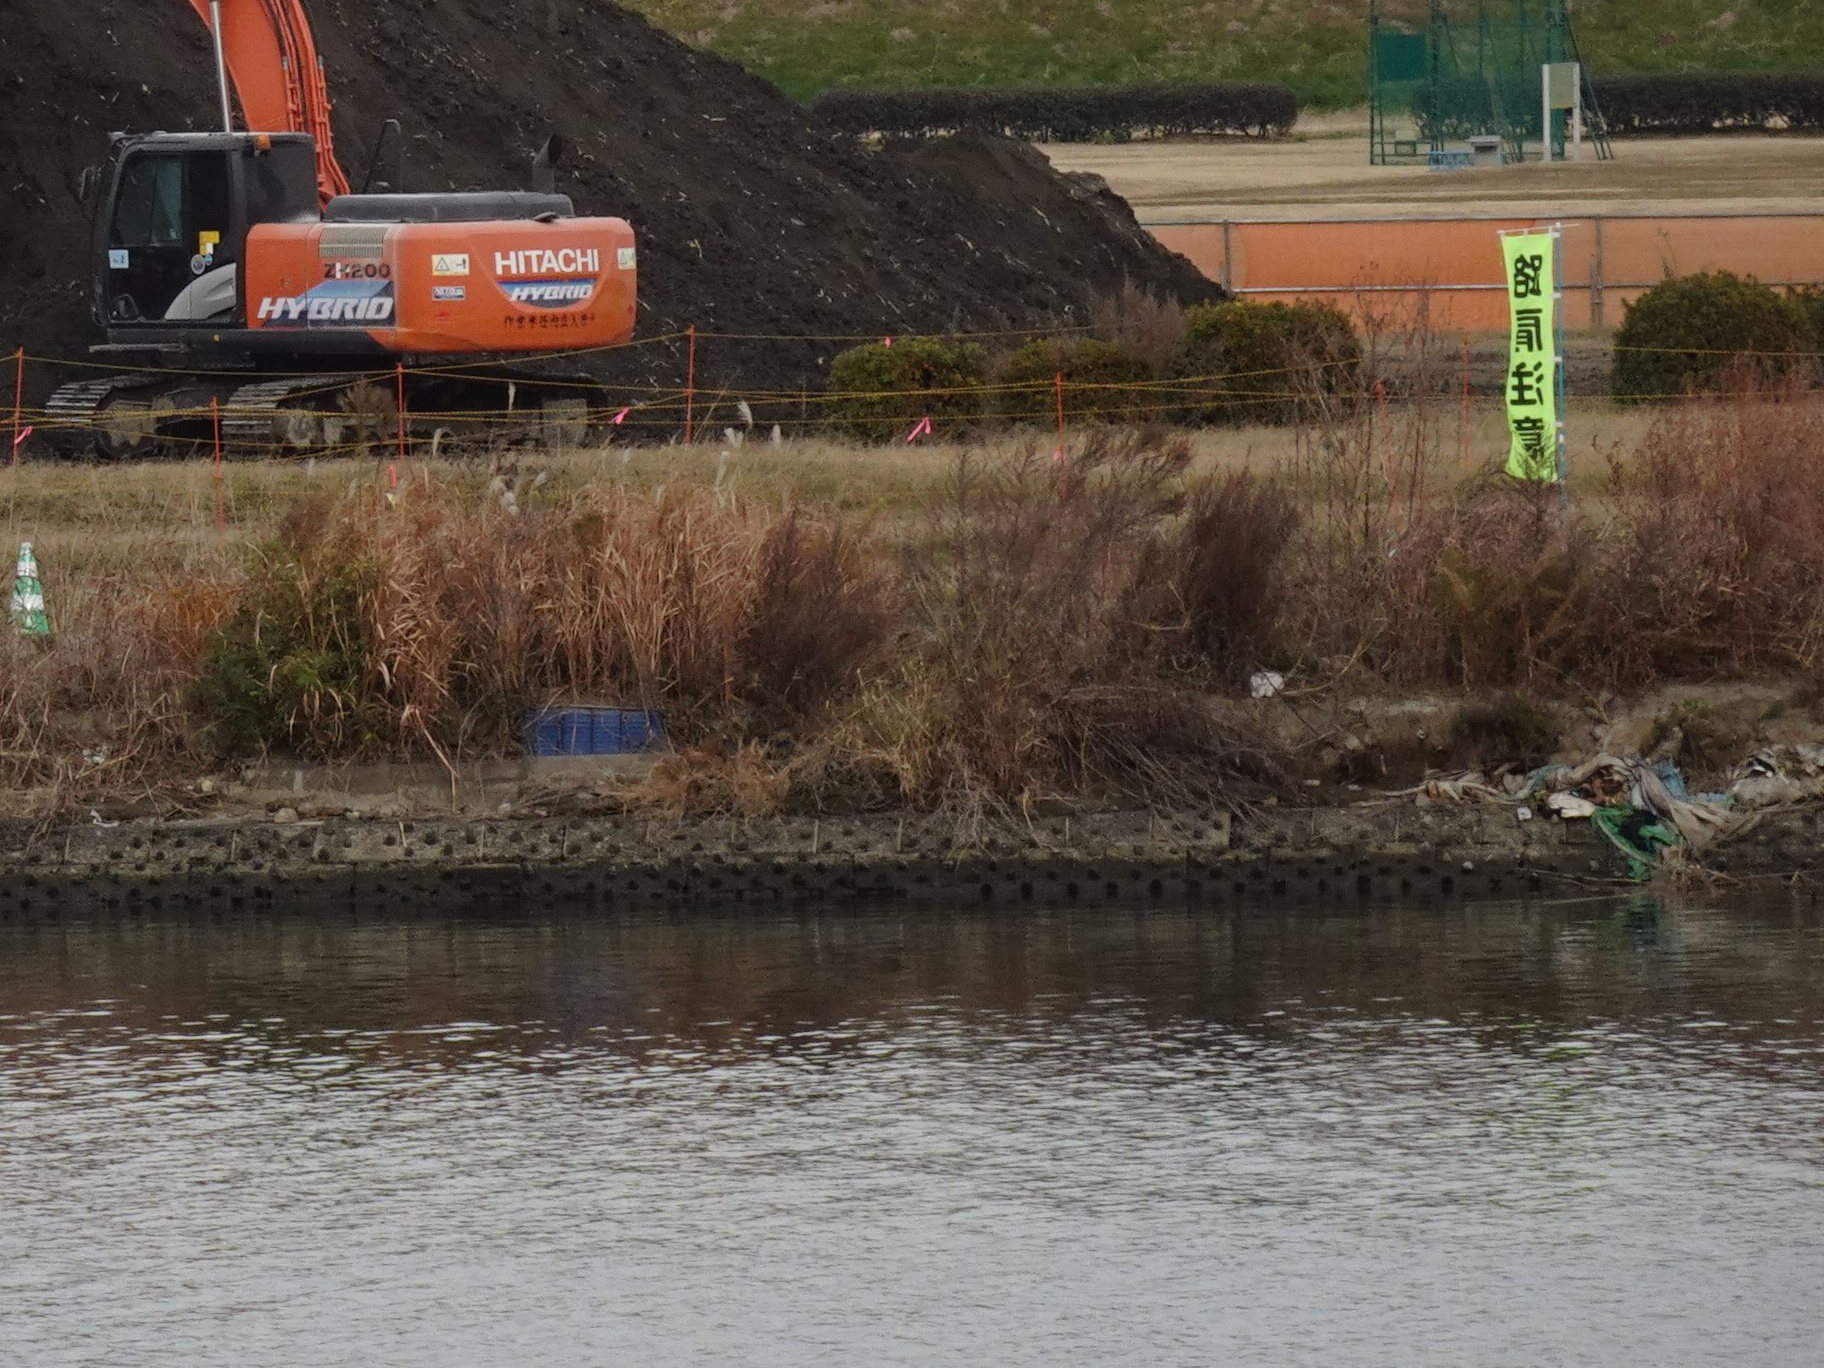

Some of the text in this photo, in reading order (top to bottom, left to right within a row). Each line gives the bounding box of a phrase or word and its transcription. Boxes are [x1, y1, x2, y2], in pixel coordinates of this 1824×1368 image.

[494, 248, 600, 275] HITACHI
[509, 284, 594, 301] HYBRID
[256, 296, 394, 320] HYBRID
